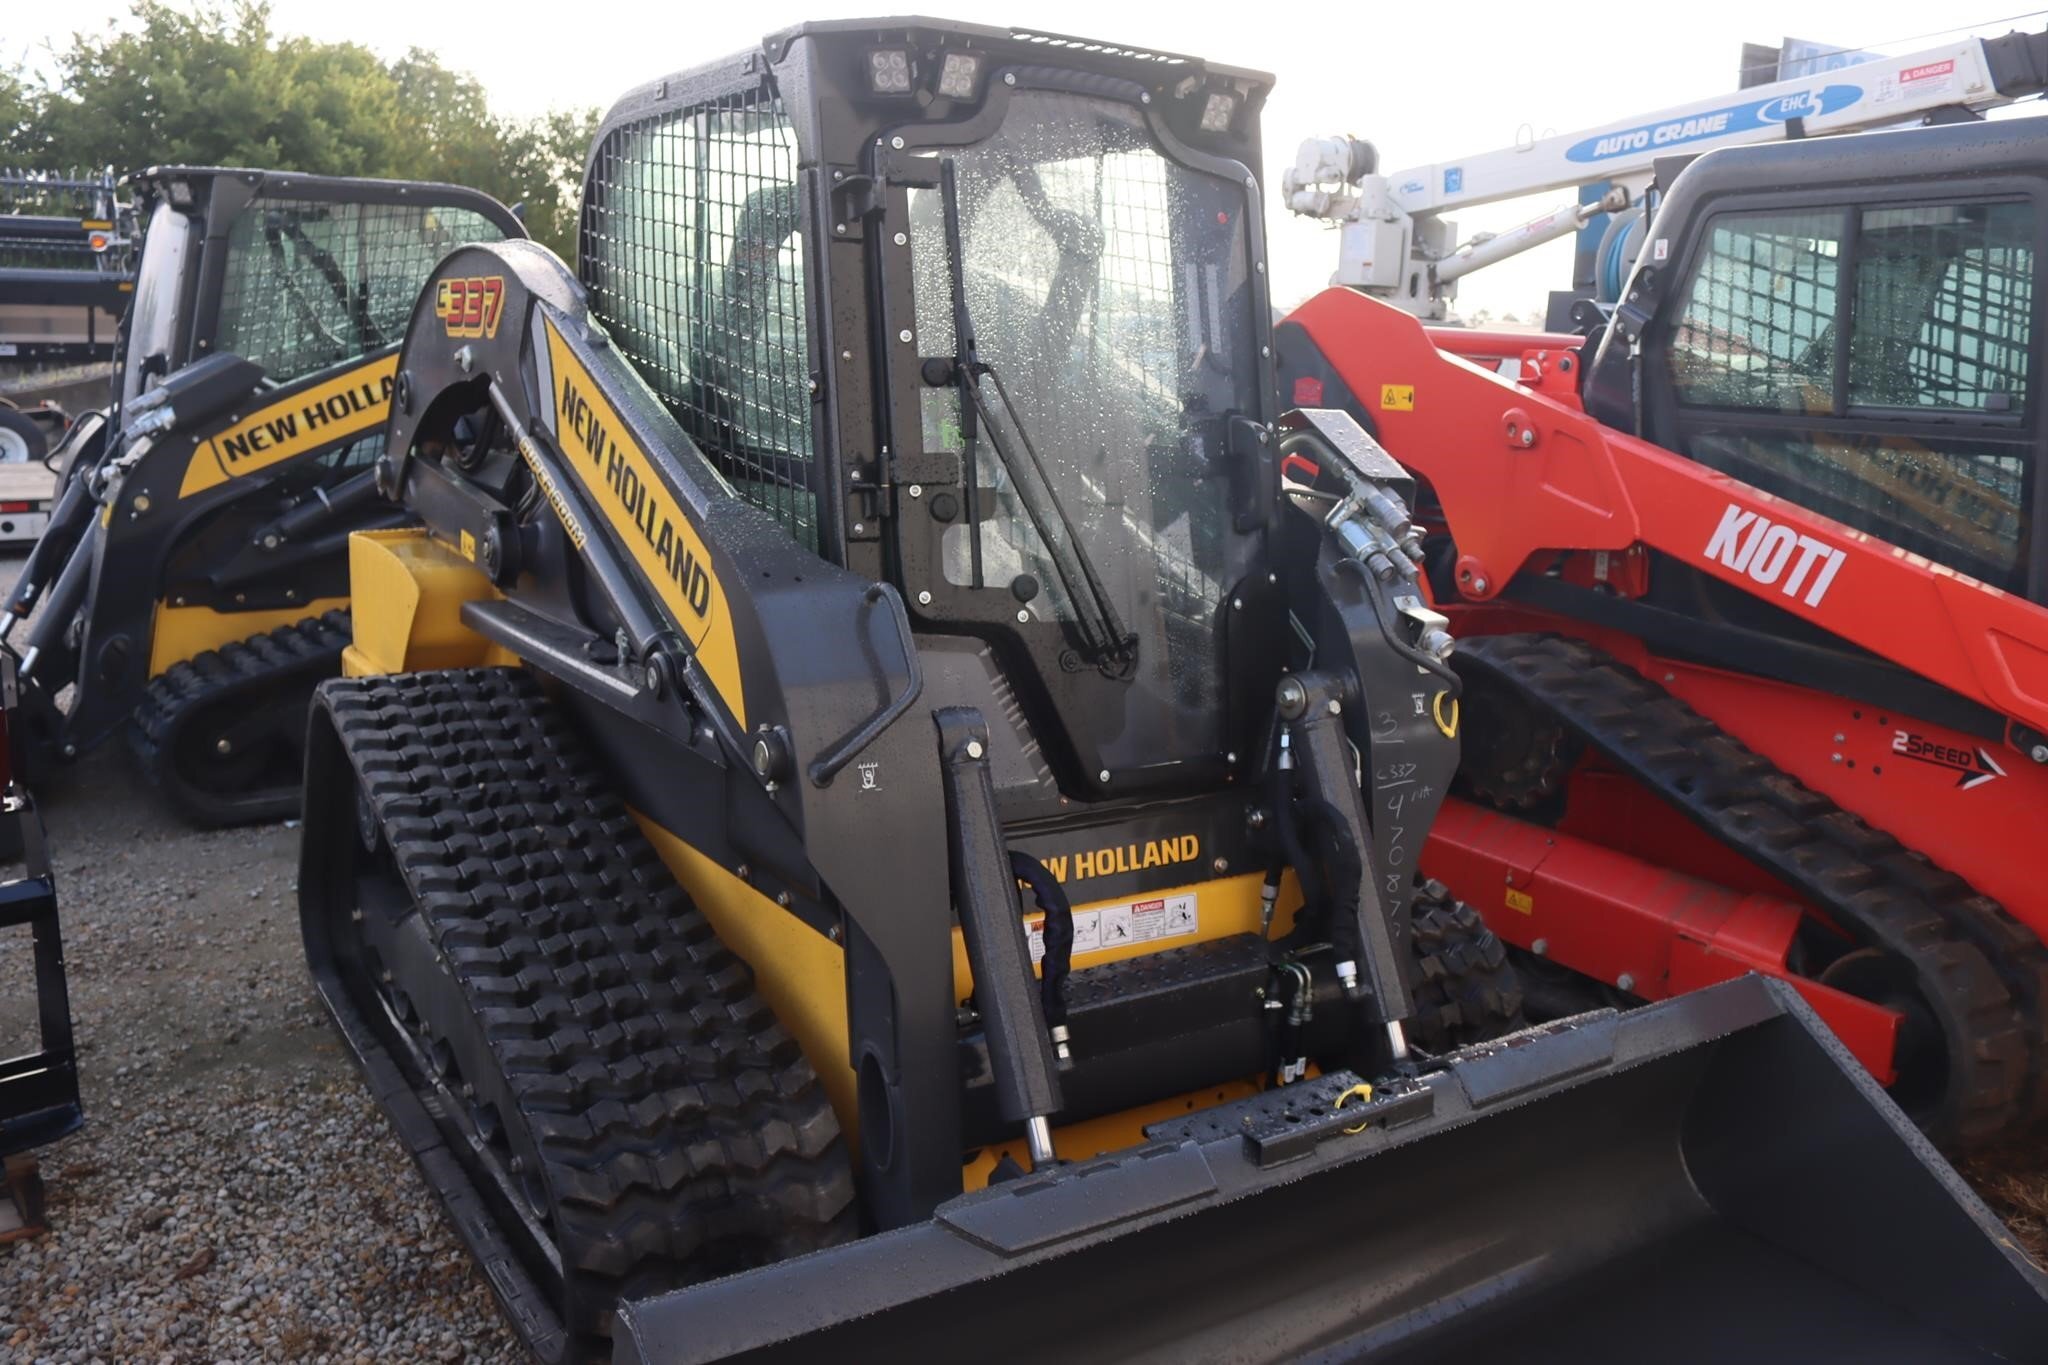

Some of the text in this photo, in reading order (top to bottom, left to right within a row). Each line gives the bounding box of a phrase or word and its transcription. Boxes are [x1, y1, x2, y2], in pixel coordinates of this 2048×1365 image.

[1912, 62, 1951, 78] DANGER
[1593, 113, 1729, 157] AUTO CRANE
[436, 276, 504, 338] C337
[222, 412, 298, 463] NEW
[561, 376, 710, 618] NEW HOLLAND
[1703, 503, 1848, 608] KIOTI
[1074, 834, 1200, 880] HOLLAND
